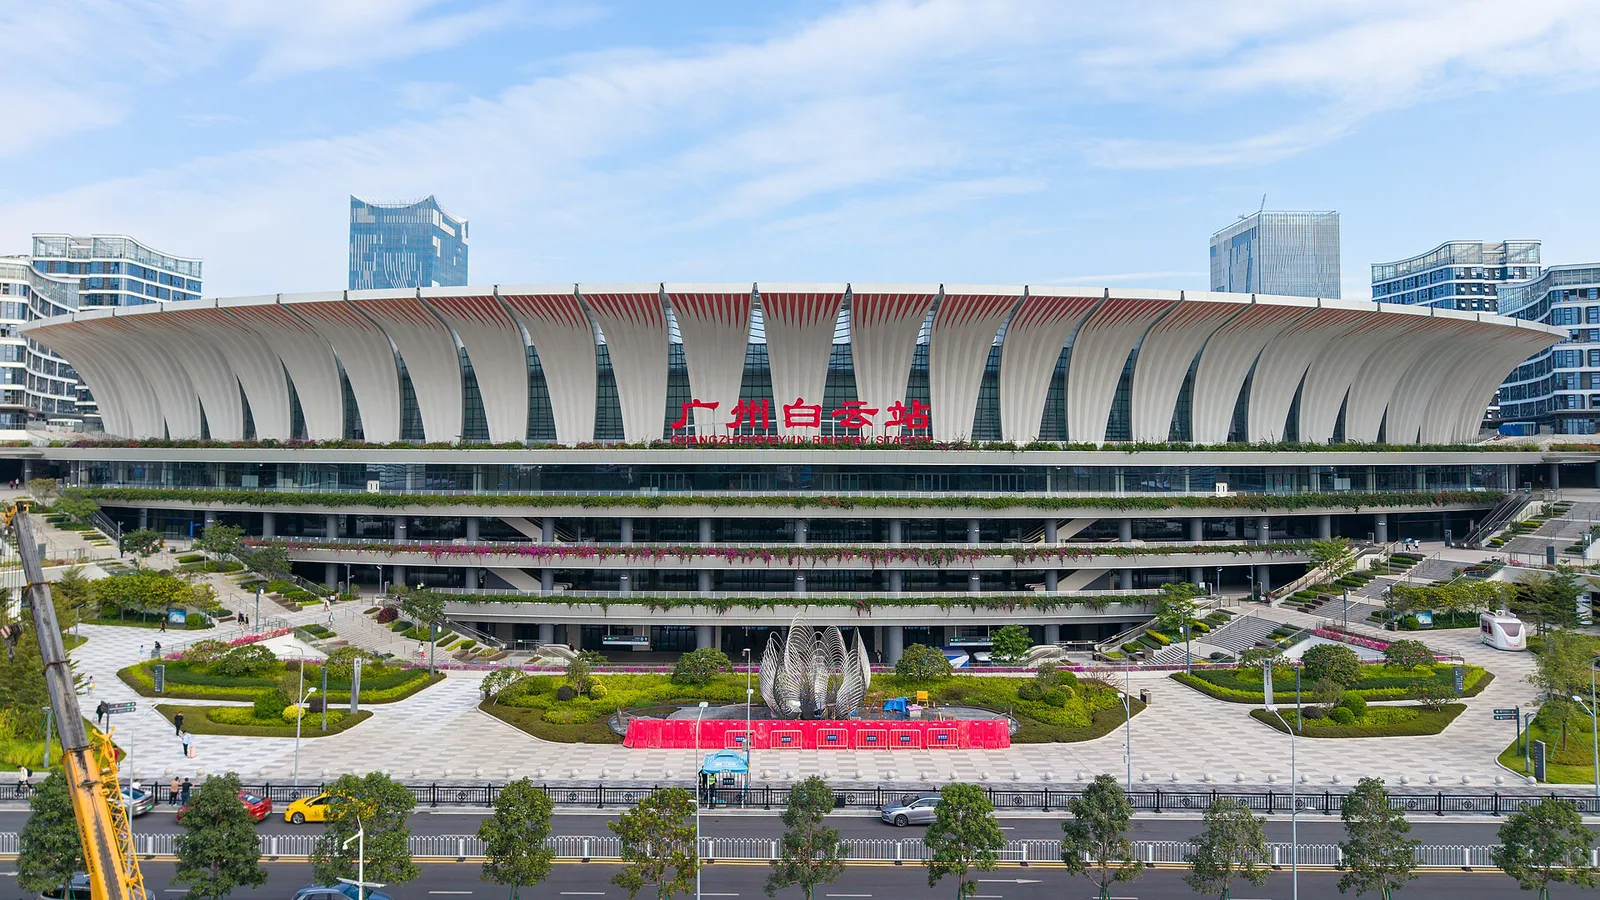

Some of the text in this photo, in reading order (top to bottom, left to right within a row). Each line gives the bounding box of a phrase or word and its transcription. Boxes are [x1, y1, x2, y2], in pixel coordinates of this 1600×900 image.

[671, 397, 931, 430] 广州白云站
